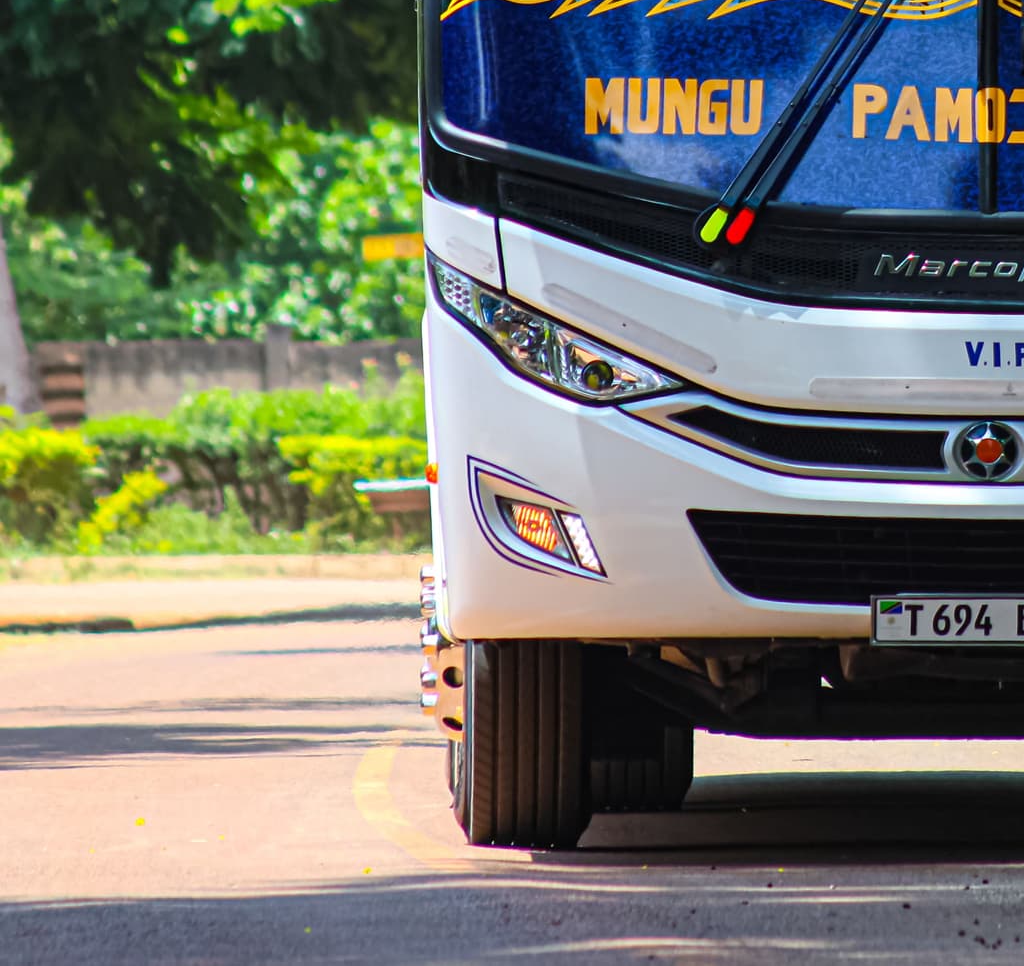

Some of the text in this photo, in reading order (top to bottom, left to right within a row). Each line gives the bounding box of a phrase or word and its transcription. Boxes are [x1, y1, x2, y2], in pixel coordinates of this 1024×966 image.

[584, 77, 764, 136] MUNGU
[904, 604, 924, 637] T
[932, 604, 993, 637] 694
